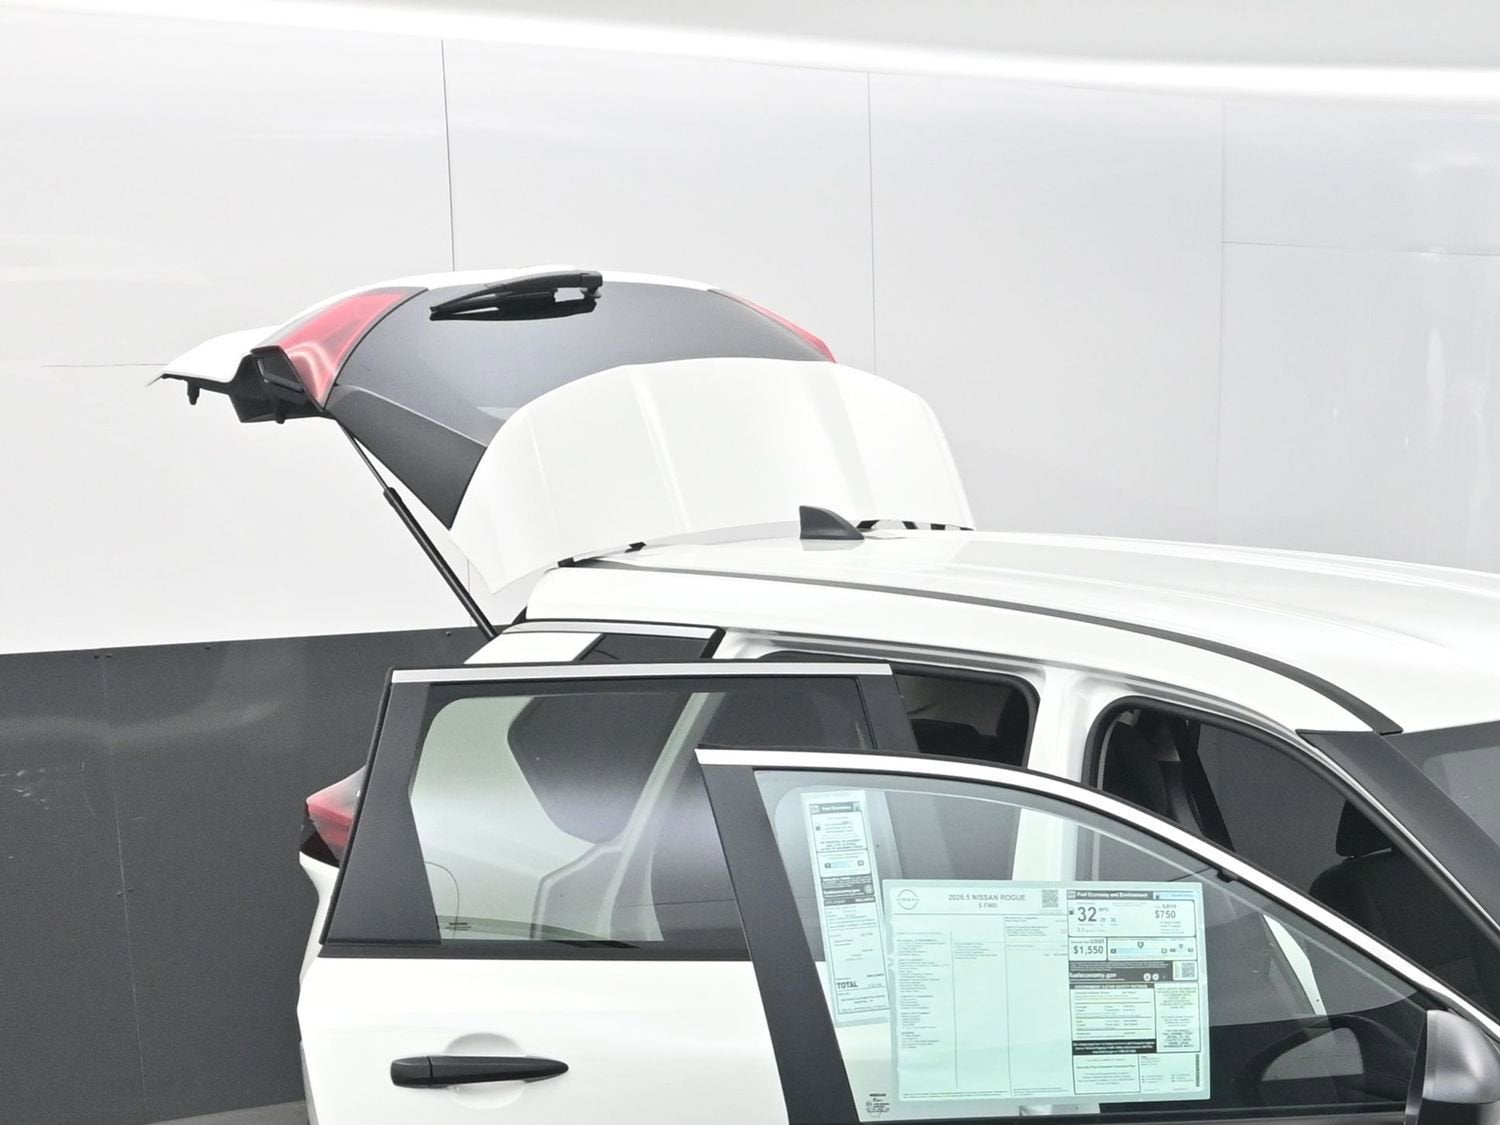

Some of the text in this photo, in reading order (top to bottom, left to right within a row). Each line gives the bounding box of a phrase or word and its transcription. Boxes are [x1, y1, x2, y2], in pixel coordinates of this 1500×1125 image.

[972, 893, 999, 901] NISSAN
[1000, 893, 1026, 901] ROGUE
[1077, 906, 1097, 922] 32
[1155, 910, 1176, 919] $750
[1073, 945, 1104, 956] $1,550
[837, 981, 859, 989] TOTAL
